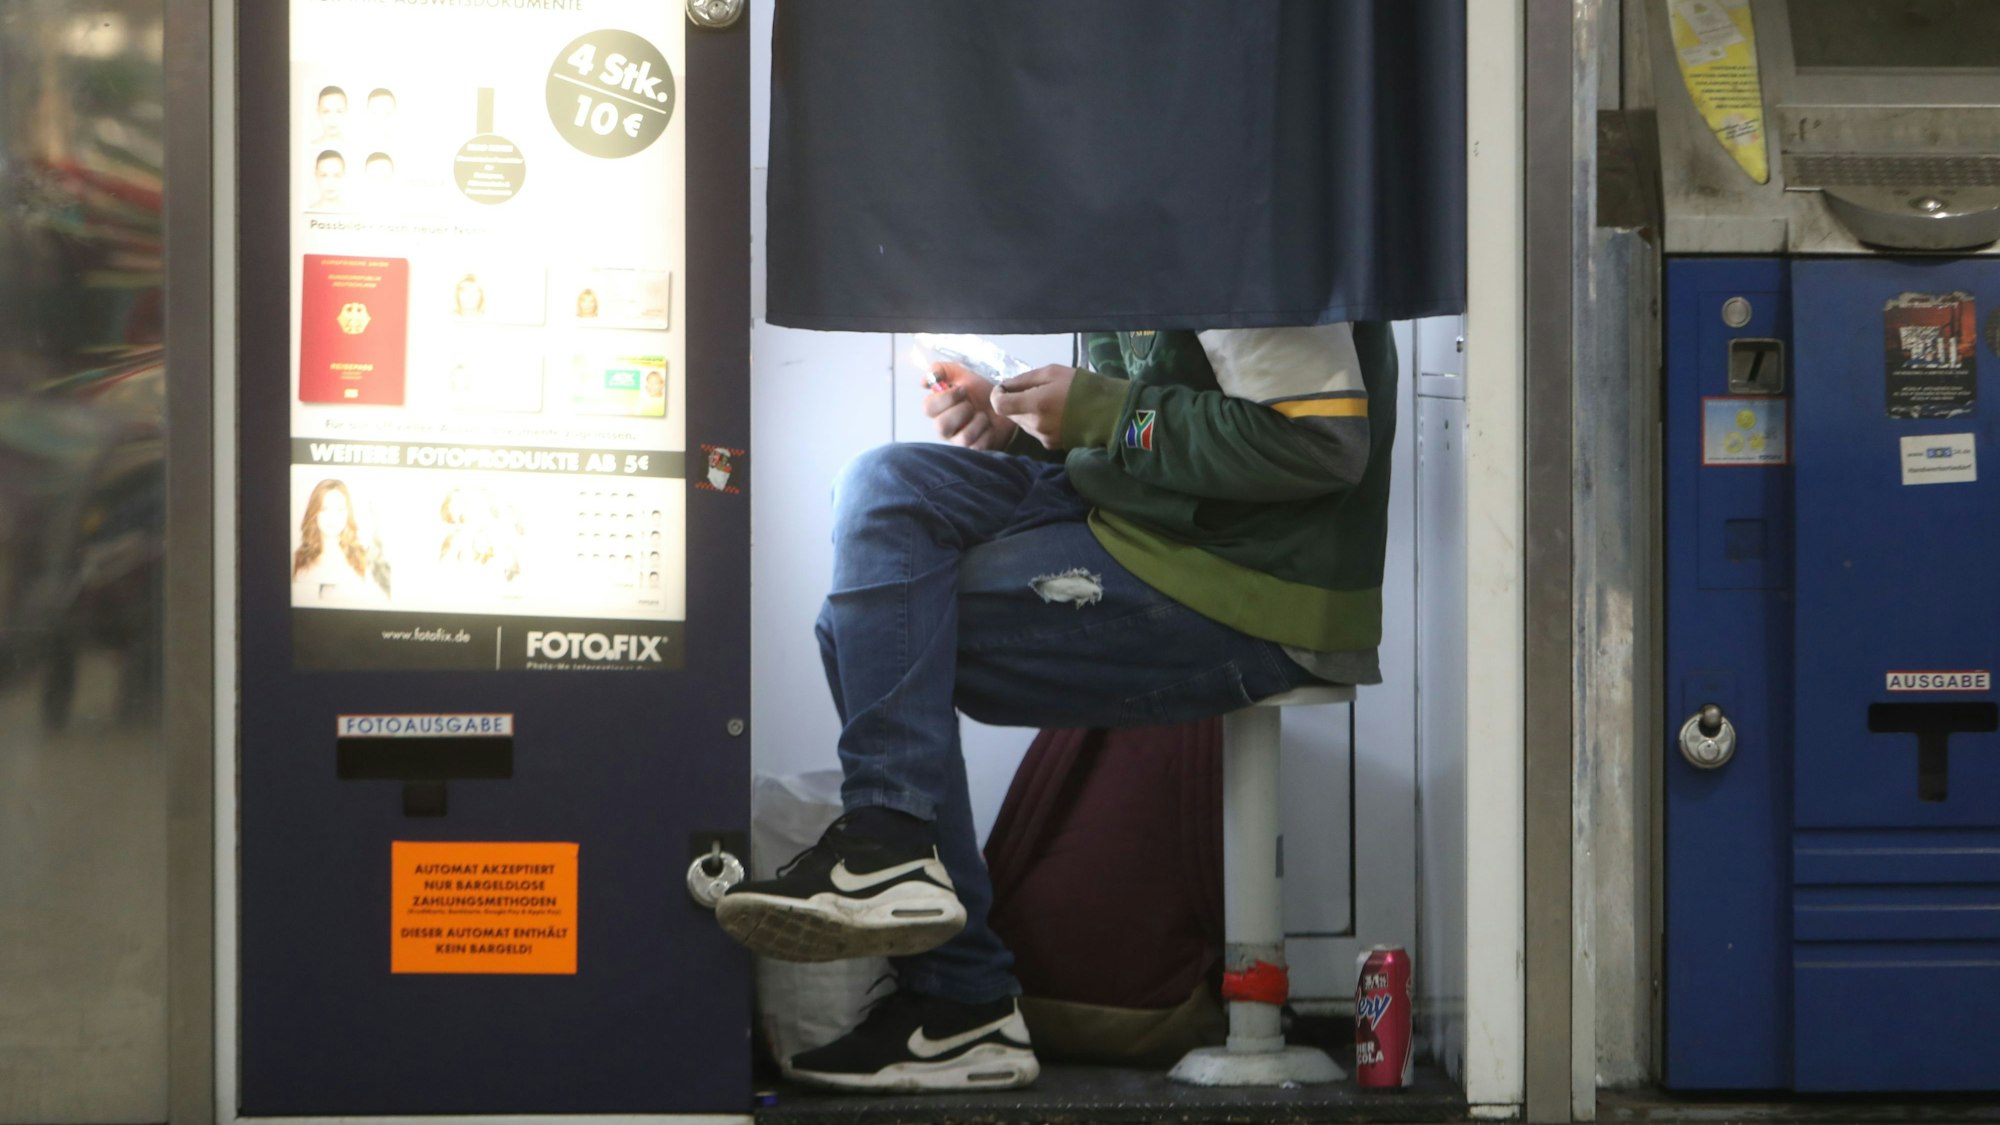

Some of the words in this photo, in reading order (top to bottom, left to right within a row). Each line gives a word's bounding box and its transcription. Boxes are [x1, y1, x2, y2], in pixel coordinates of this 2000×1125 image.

[567, 43, 597, 76] 4
[598, 53, 669, 103] Stk.
[573, 93, 619, 136] 10
[622, 112, 644, 138] €
[310, 443, 400, 465] WEITERE
[406, 446, 580, 473] FOTOPRODUKTE
[585, 452, 617, 473] AB
[382, 627, 471, 643] www.fotofix.de
[1889, 675, 1985, 688] AUSGABE
[346, 717, 503, 733] FOTOAUSGABE
[415, 864, 478, 875] AUTOMAT
[481, 864, 555, 875] AKZEPTIERT
[424, 880, 452, 891] NUR
[456, 880, 545, 891] BARGELDLOSE
[412, 896, 557, 907] ZAHLUNGSMETHODEN
[400, 928, 442, 939] DIESER
[446, 927, 510, 939] AUTOMAT
[514, 925, 568, 939] ENTHÄLT
[435, 944, 467, 955] KEIN
[470, 944, 533, 955] BARGELD!
[1357, 991, 1393, 1032] ery
[1357, 1050, 1385, 1065] COLA
